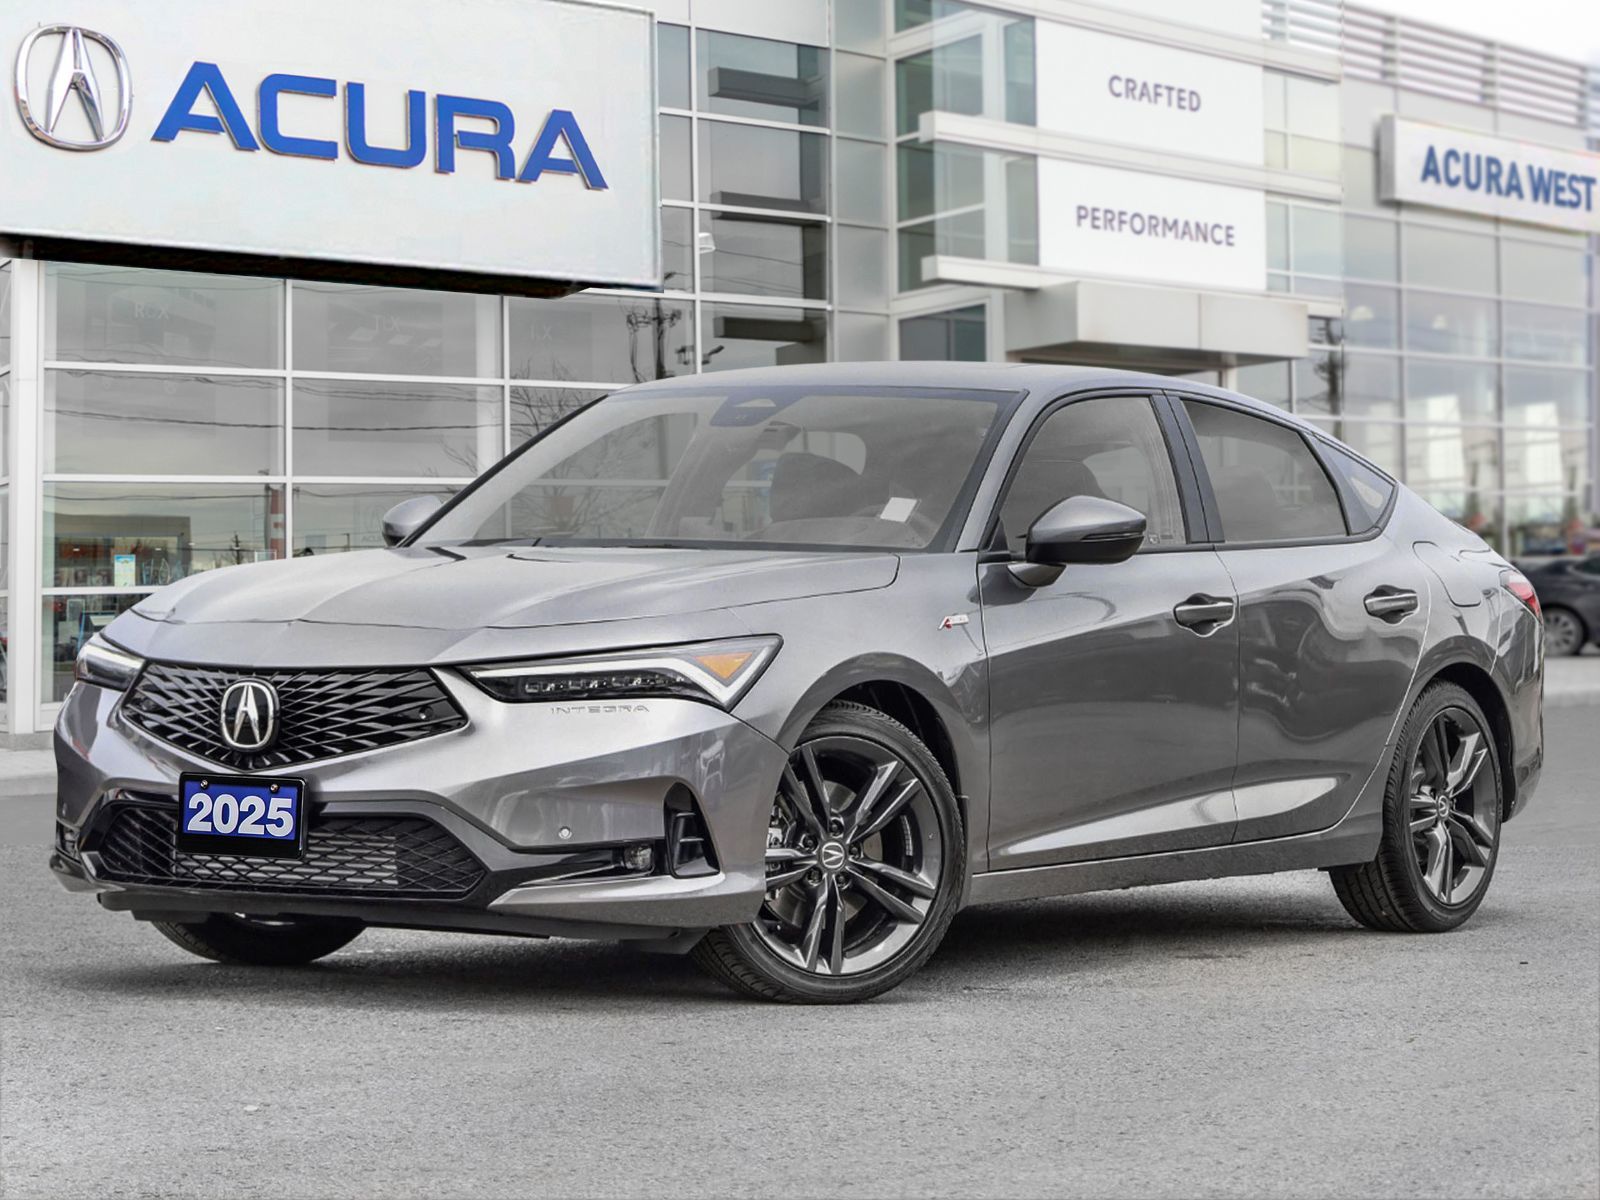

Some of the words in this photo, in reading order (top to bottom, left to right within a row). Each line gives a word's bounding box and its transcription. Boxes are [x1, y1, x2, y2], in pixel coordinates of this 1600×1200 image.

[1108, 75, 1202, 112] CRAFTED
[151, 61, 609, 190] ACURA
[1421, 145, 1525, 200] ACURA
[1527, 164, 1597, 212] WEST
[1076, 204, 1235, 247] PERFORMANCE
[551, 704, 650, 714] INTEGRA
[187, 792, 294, 837] 2025
